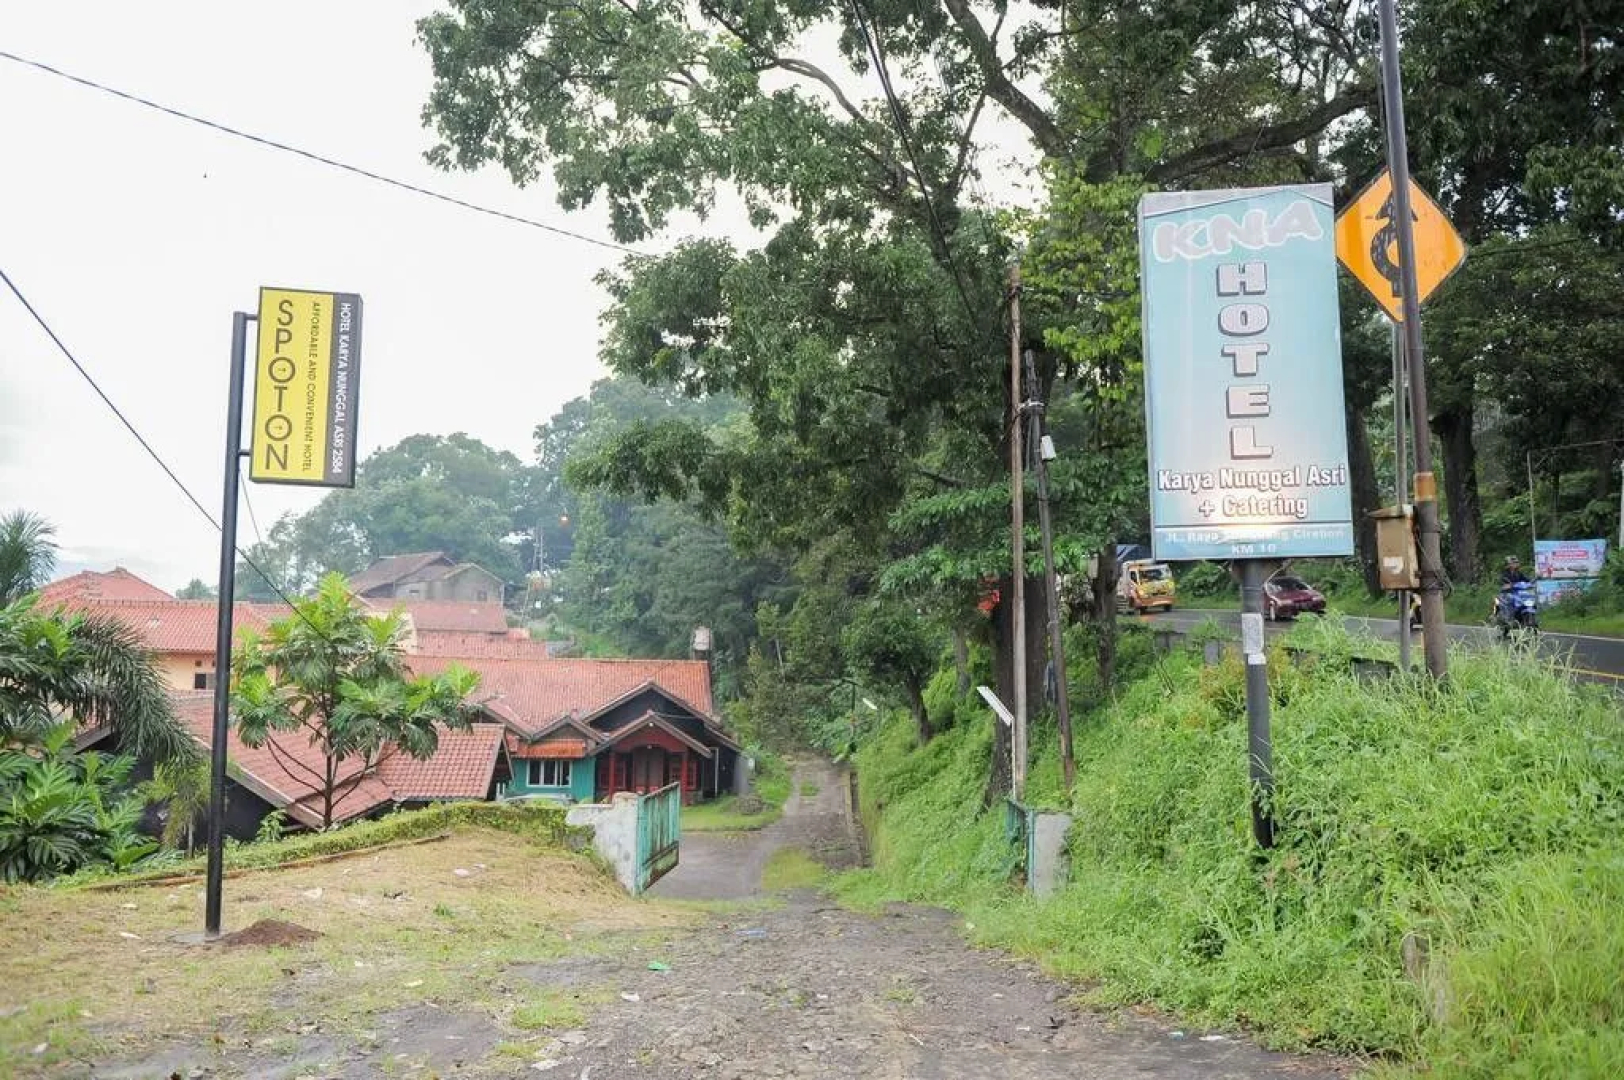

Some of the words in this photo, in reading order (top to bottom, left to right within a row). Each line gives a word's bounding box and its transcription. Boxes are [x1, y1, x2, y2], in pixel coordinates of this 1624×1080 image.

[1153, 201, 1324, 263] KNA
[308, 302, 320, 358] AFFORDABLE
[339, 302, 351, 332] HOTEL
[337, 334, 350, 369] KARYA
[1216, 261, 1274, 460] HOTEL
[264, 299, 296, 471] SPOTON
[307, 359, 317, 382] AND
[304, 383, 316, 442] CONVENIENT
[334, 370, 348, 422] NUNGGAL
[332, 424, 345, 448] ASRI
[302, 443, 312, 472] HOTEL
[1158, 468, 1214, 494] Karya
[1219, 465, 1300, 491] Nunggal
[1306, 463, 1346, 487] Asri
[1222, 495, 1309, 519] Catering
[1231, 544, 1254, 554] KM
